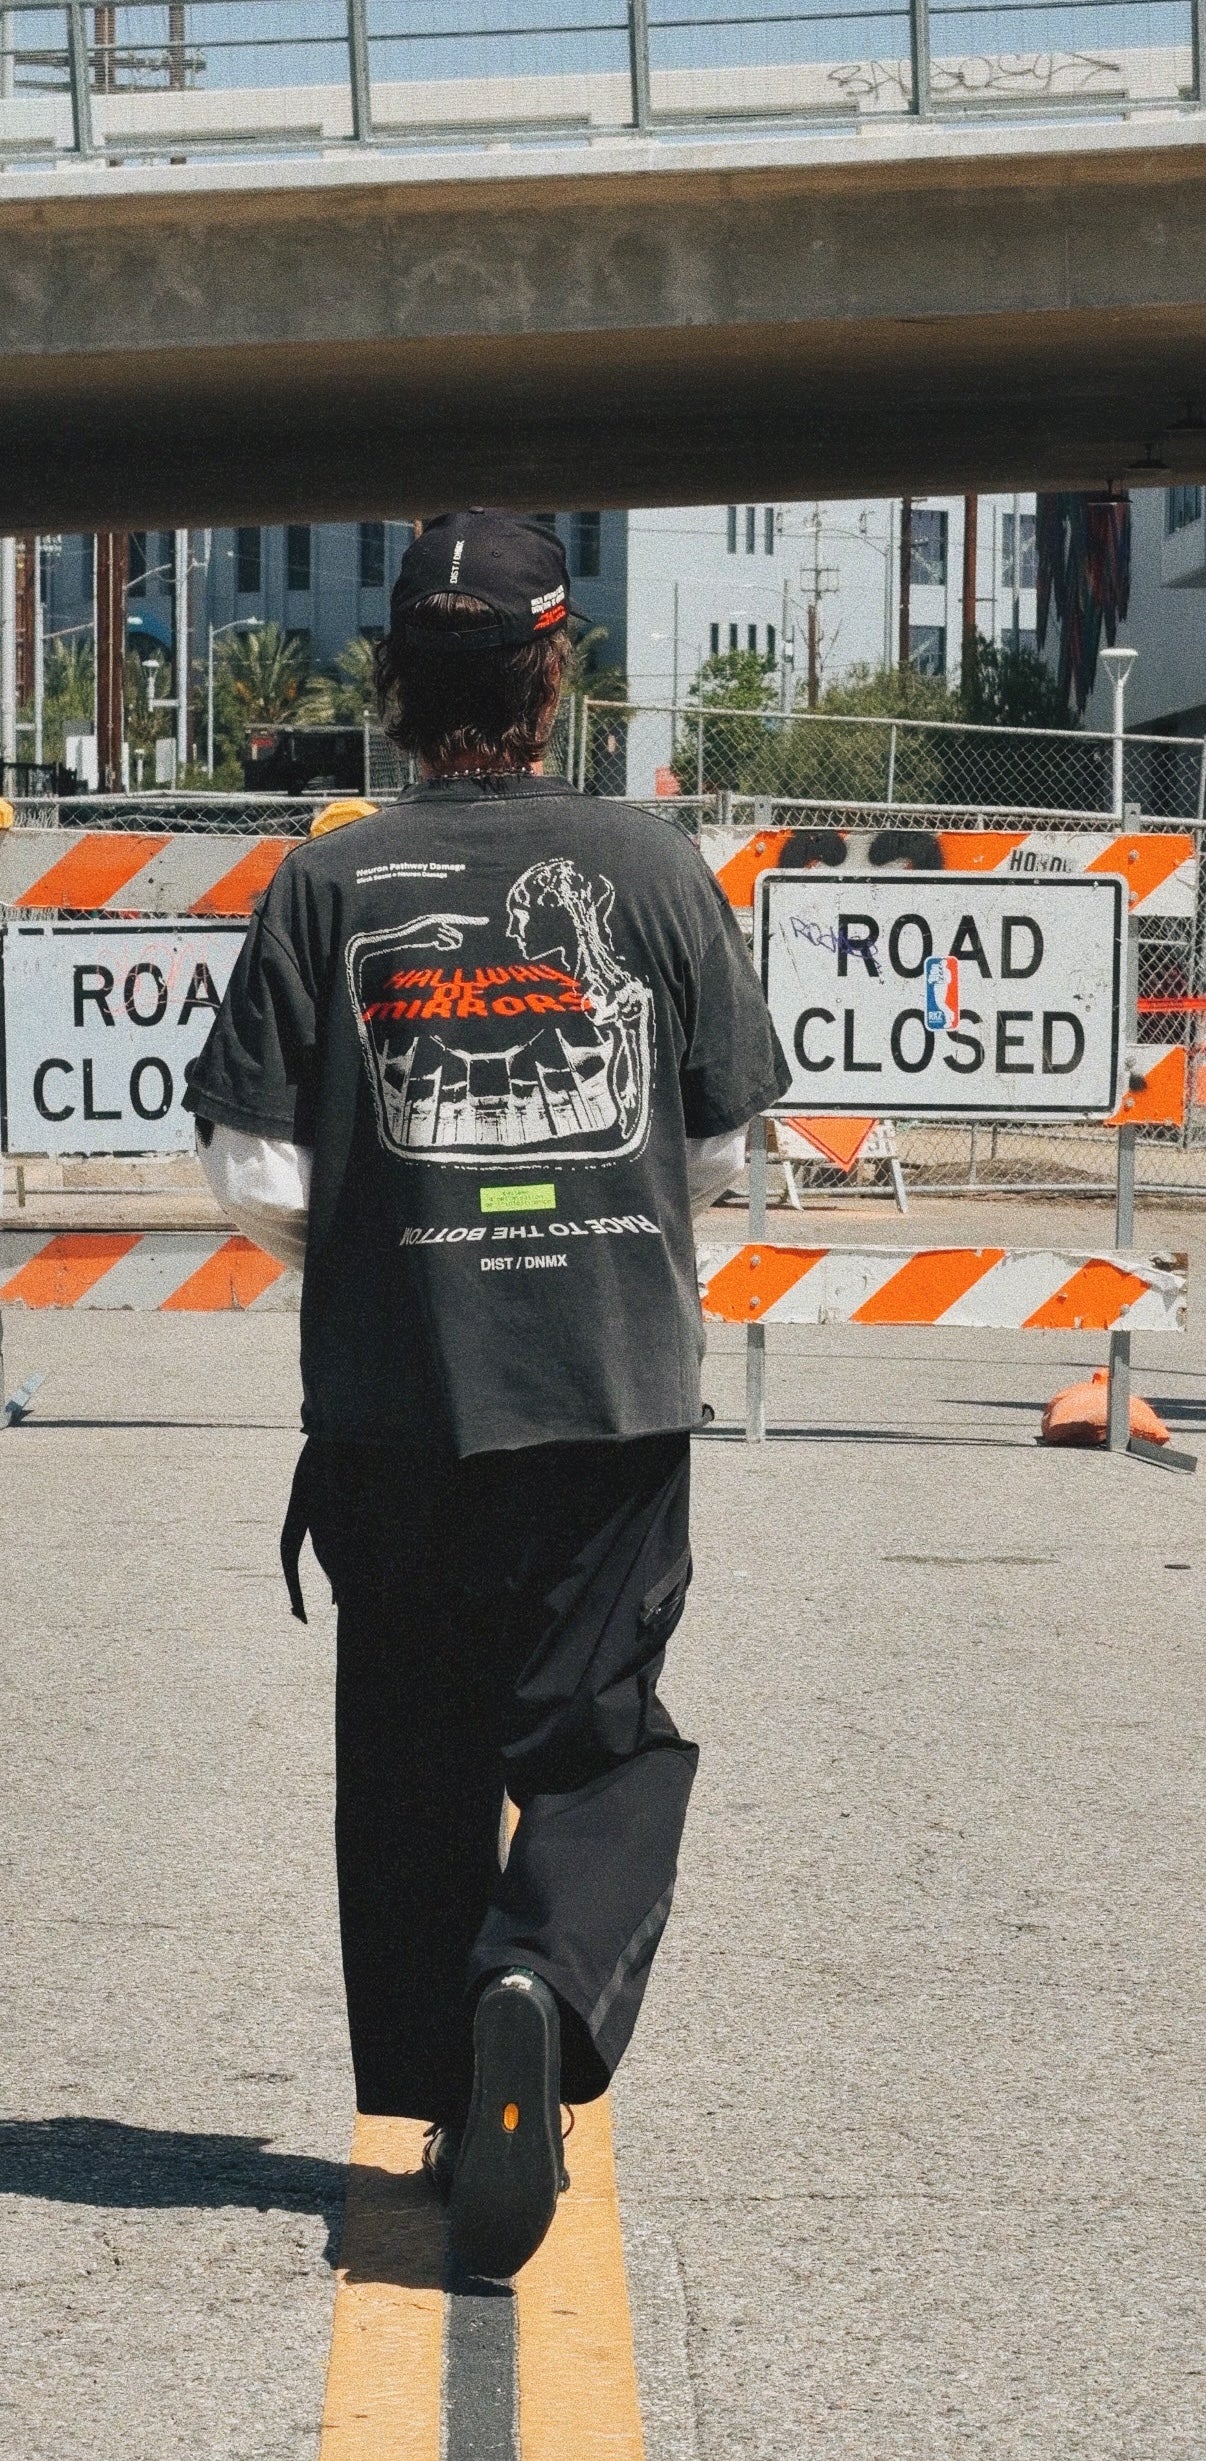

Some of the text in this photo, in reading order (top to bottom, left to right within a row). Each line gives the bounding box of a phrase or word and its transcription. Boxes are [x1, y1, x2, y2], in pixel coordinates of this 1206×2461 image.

[356, 862, 466, 877] Neuron Pathway Damage
[837, 913, 1044, 979] ROAD
[73, 963, 223, 1027] ROA
[794, 1008, 1085, 1075] CLOSED
[33, 1056, 198, 1122] CLO
[399, 1214, 662, 1246] RACE TO THE BOTTOM
[480, 1254, 568, 1271] DIST / DNMX
